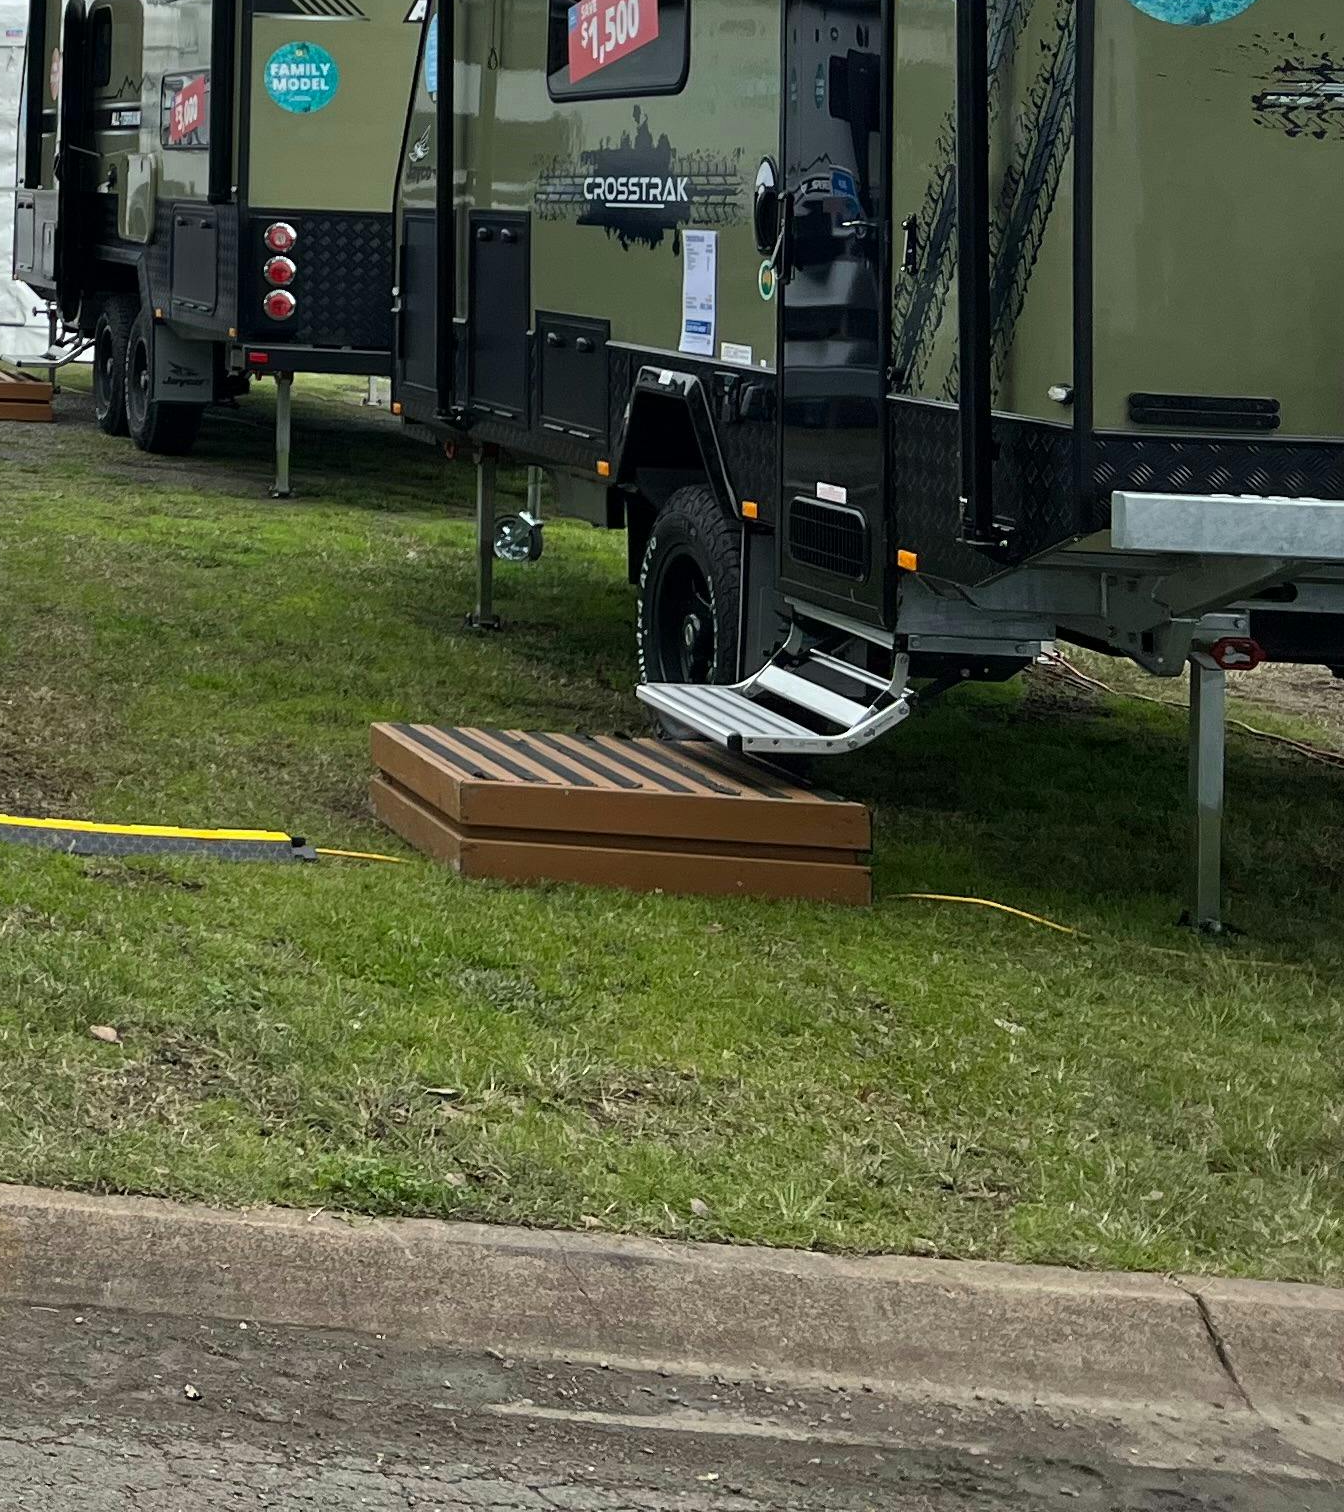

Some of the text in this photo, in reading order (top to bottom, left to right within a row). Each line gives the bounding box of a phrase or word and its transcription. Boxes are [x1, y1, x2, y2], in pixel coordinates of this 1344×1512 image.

[270, 63, 330, 77] FAMILY
[273, 78, 329, 91] MODEL
[583, 176, 689, 202] CROSSTRAK
